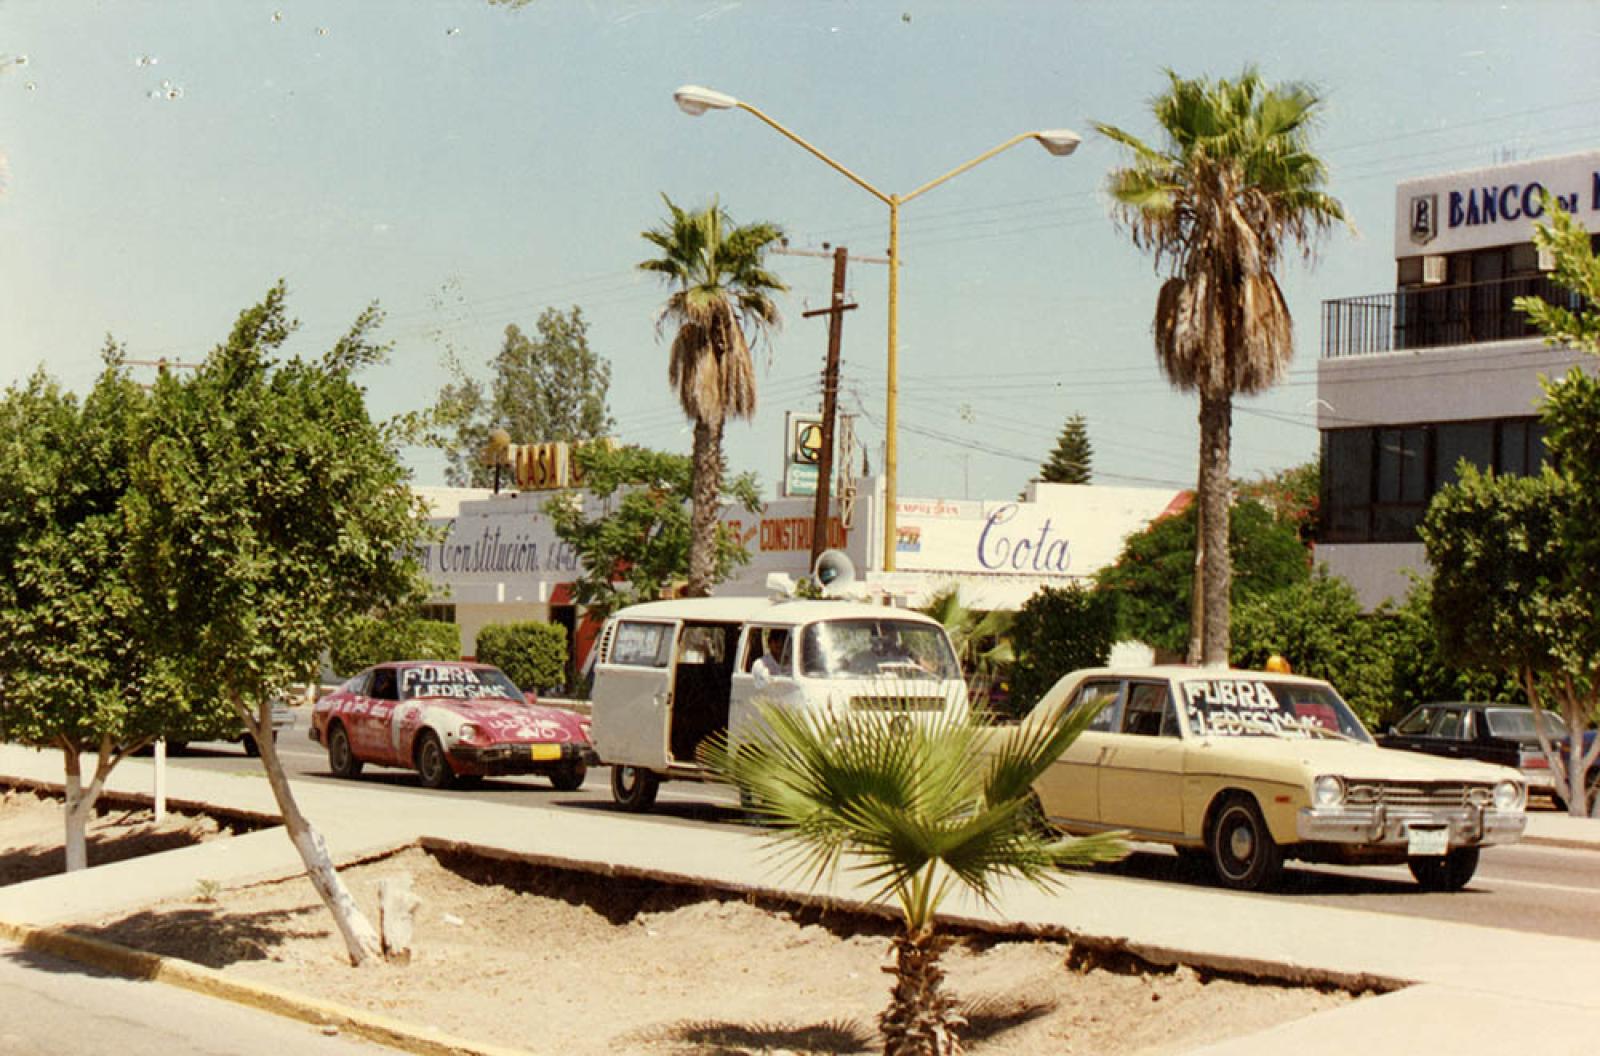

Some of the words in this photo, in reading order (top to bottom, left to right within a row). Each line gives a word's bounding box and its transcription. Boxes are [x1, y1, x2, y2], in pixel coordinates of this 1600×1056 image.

[1447, 181, 1546, 228] BANCO
[514, 442, 558, 487] CASA
[977, 503, 1071, 572] Cota
